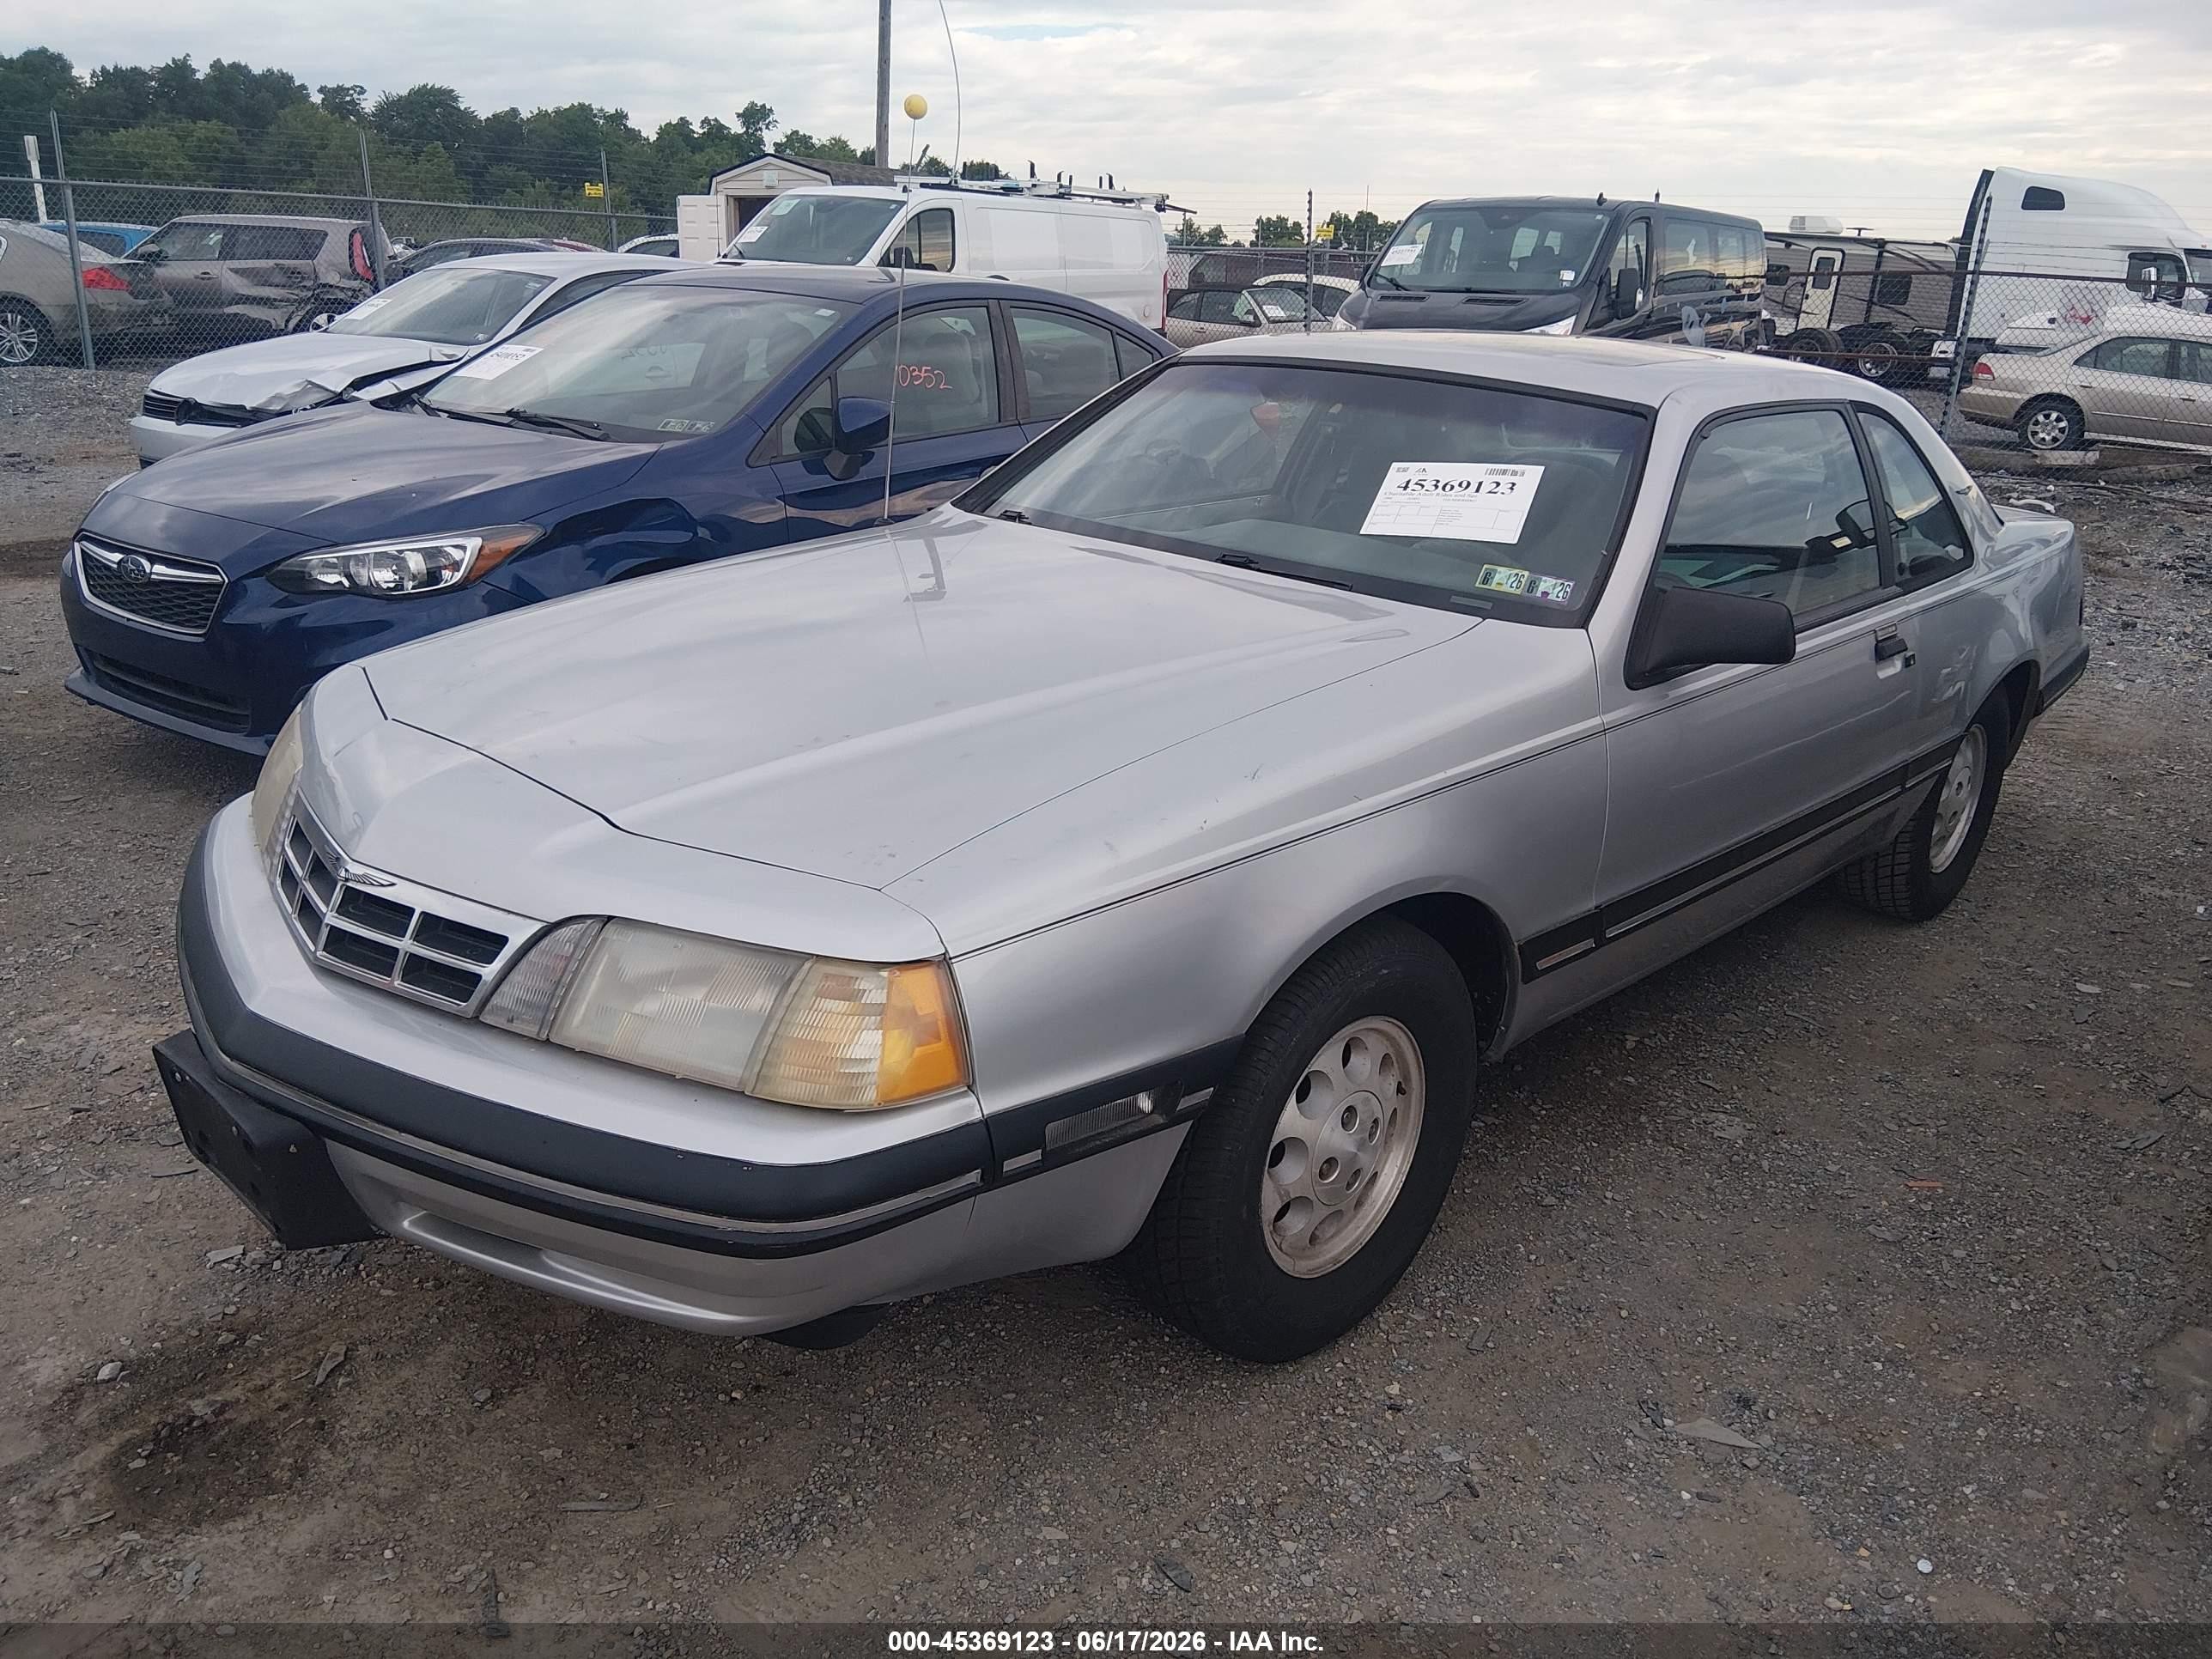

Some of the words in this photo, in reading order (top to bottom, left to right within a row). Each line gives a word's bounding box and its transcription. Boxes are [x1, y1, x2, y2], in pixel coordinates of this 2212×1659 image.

[1397, 478, 1516, 495] 45369123
[1482, 572, 1492, 586] 6
[1510, 573, 1525, 590] 26
[1527, 580, 1536, 594] 6
[1556, 582, 1571, 599] 26
